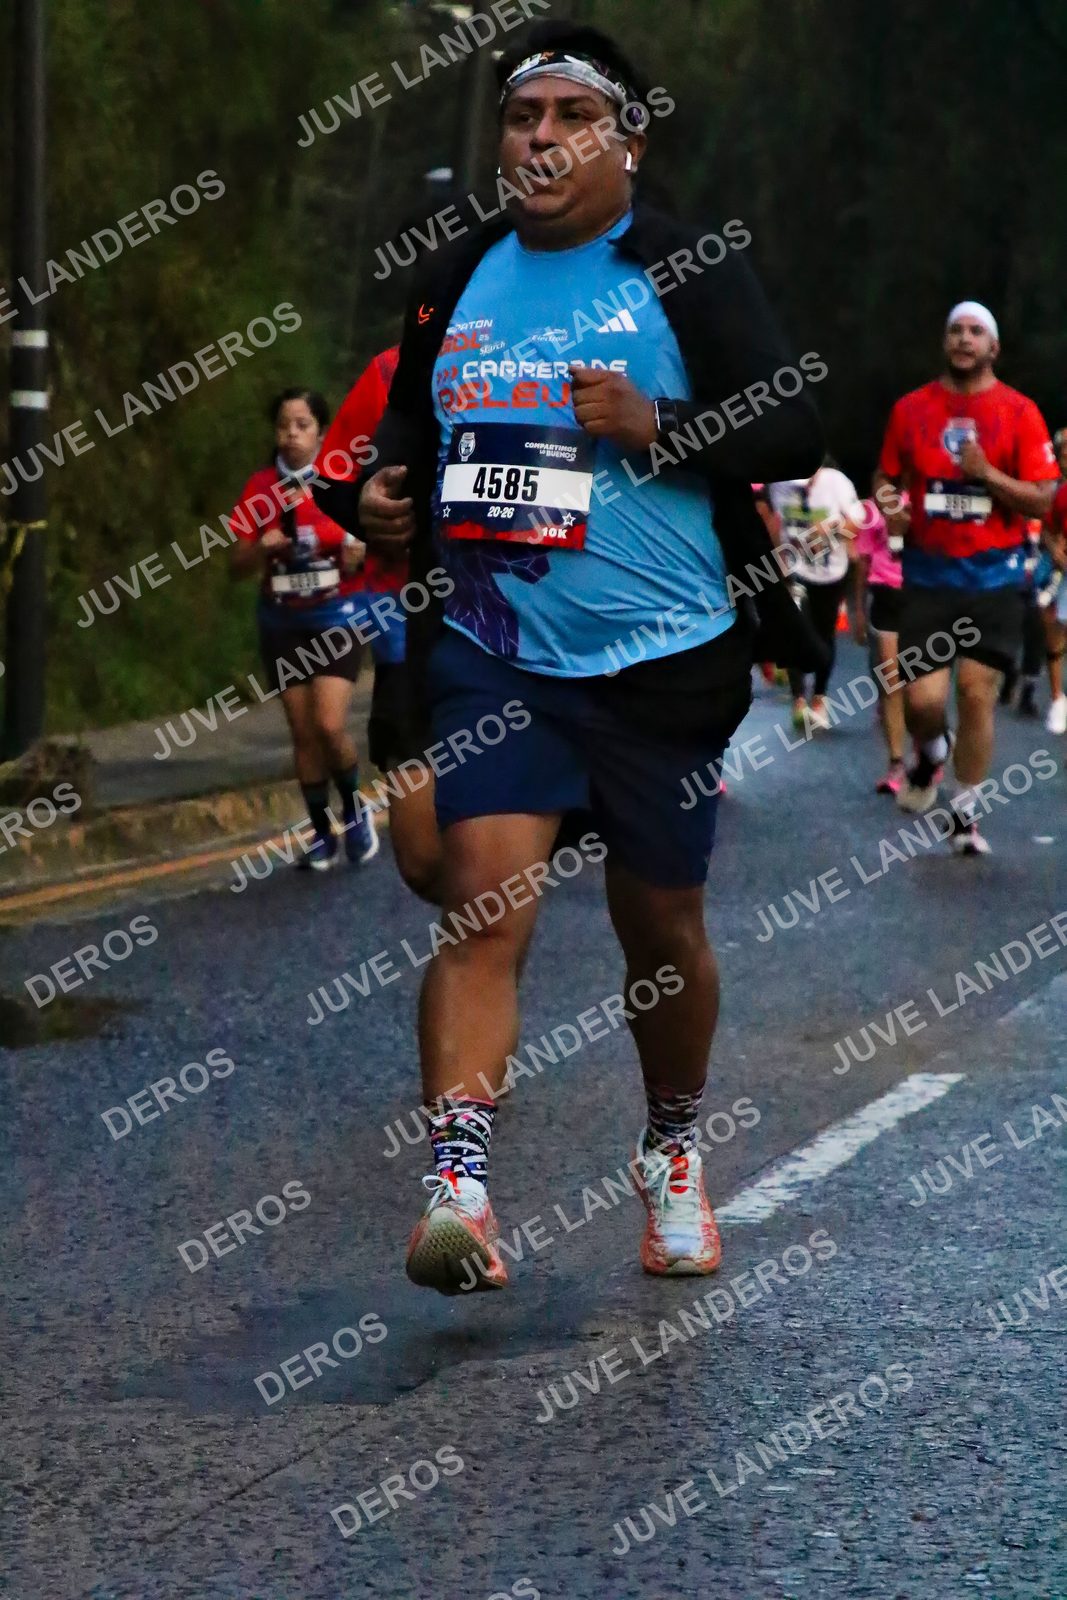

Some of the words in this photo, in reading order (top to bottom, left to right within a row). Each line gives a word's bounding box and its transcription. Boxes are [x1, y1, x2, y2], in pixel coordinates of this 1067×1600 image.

[524, 441, 578, 453] COMPARTIMOS
[472, 466, 540, 502] 4585
[542, 527, 567, 539] 10K
